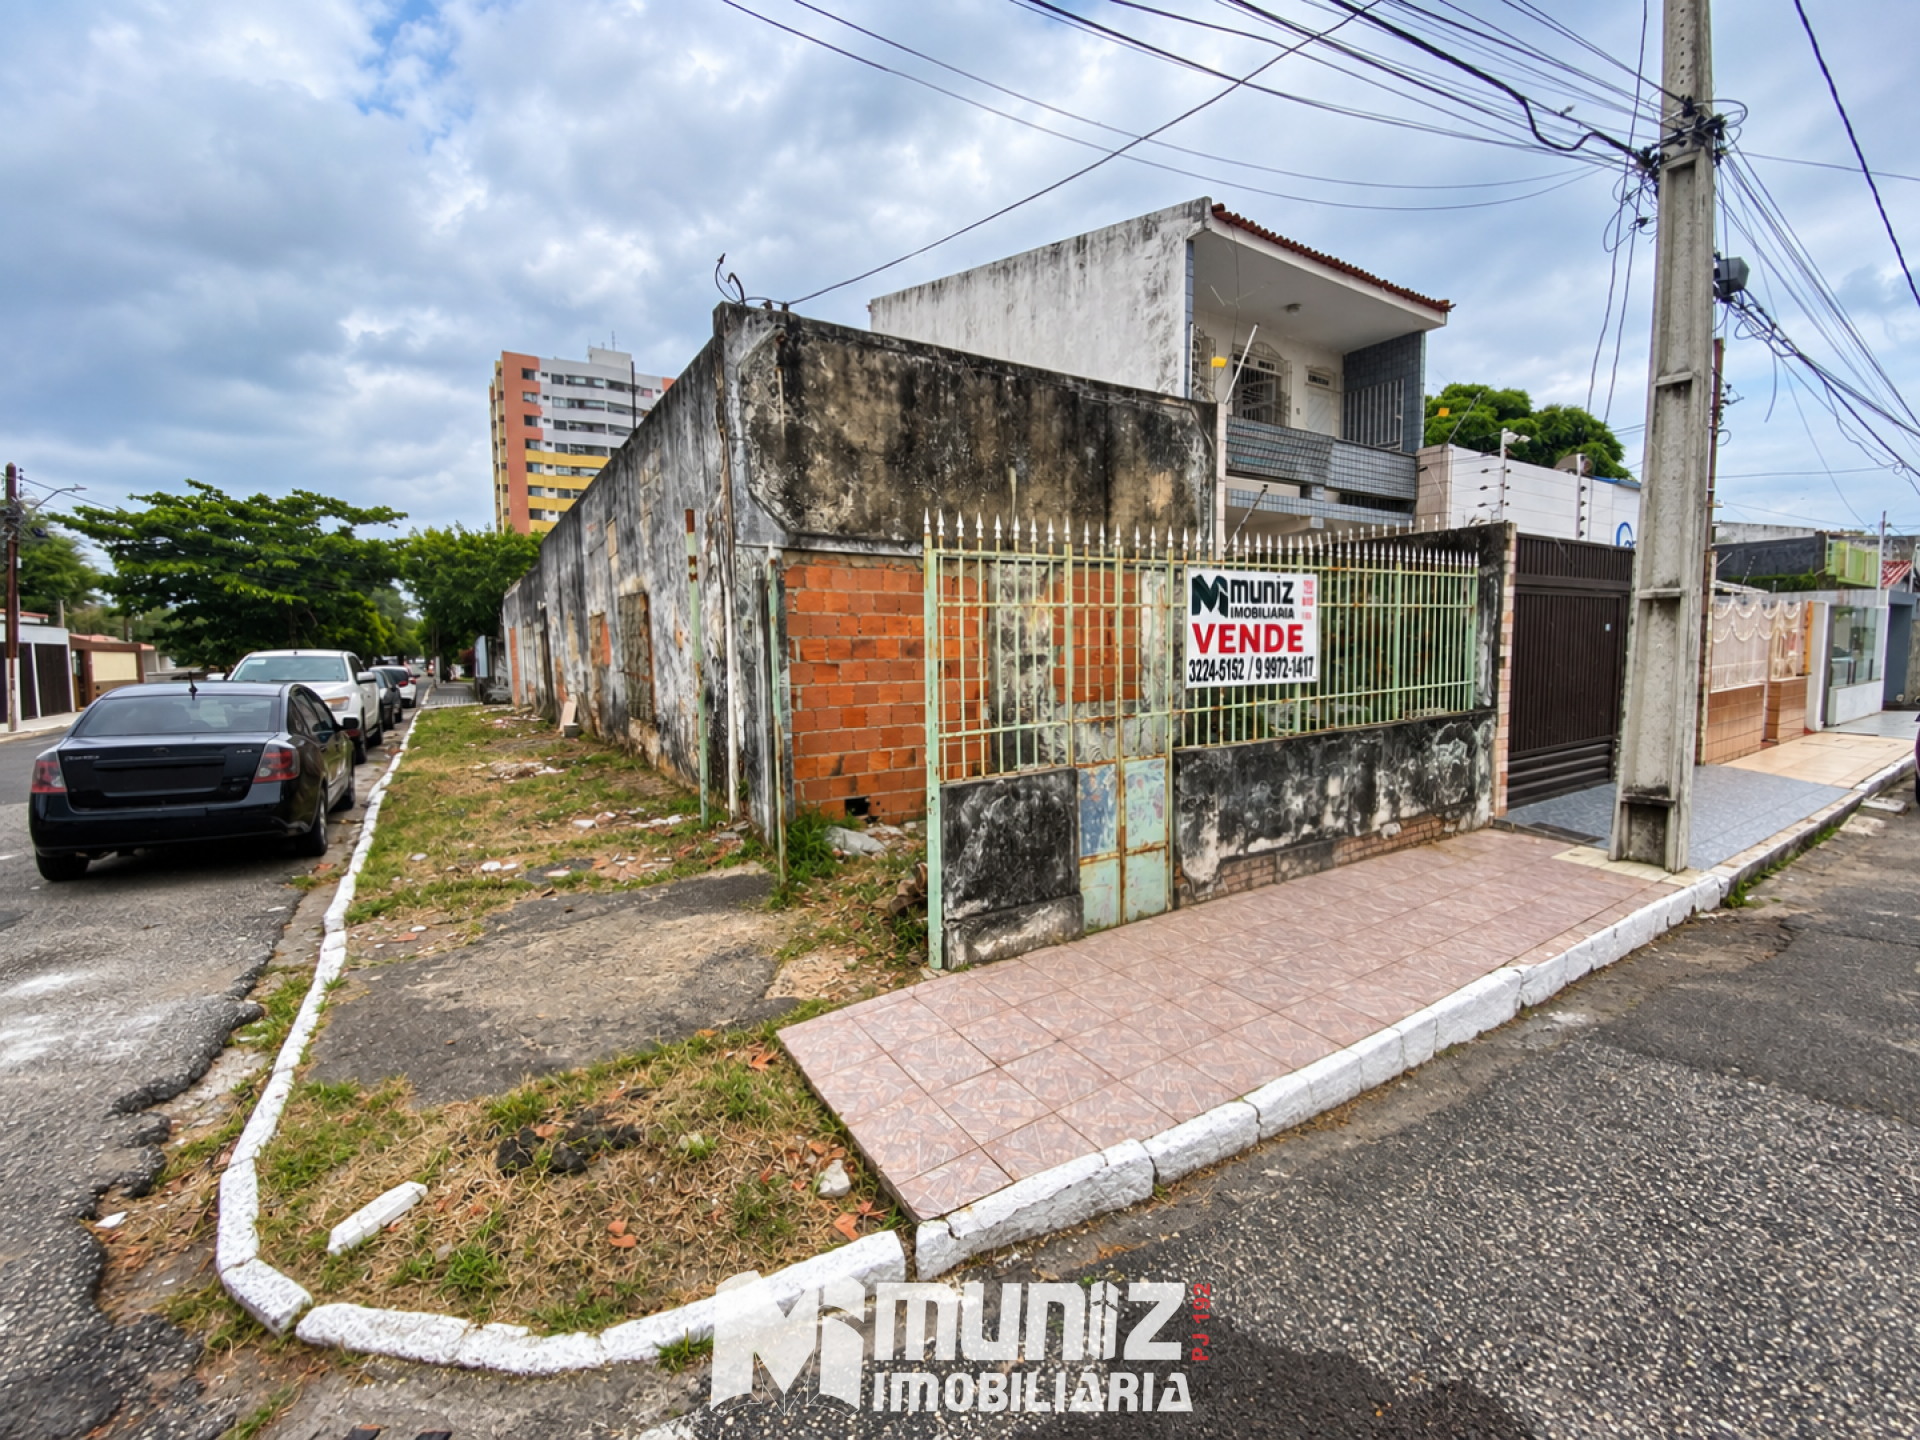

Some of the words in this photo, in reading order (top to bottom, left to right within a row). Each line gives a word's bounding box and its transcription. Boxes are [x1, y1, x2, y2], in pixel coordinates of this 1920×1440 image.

[1191, 623, 1304, 654] VENDE
[1189, 658, 1245, 682] 3224-5152
[1255, 658, 1263, 679] 9
[1264, 656, 1315, 679] 9972-1417
